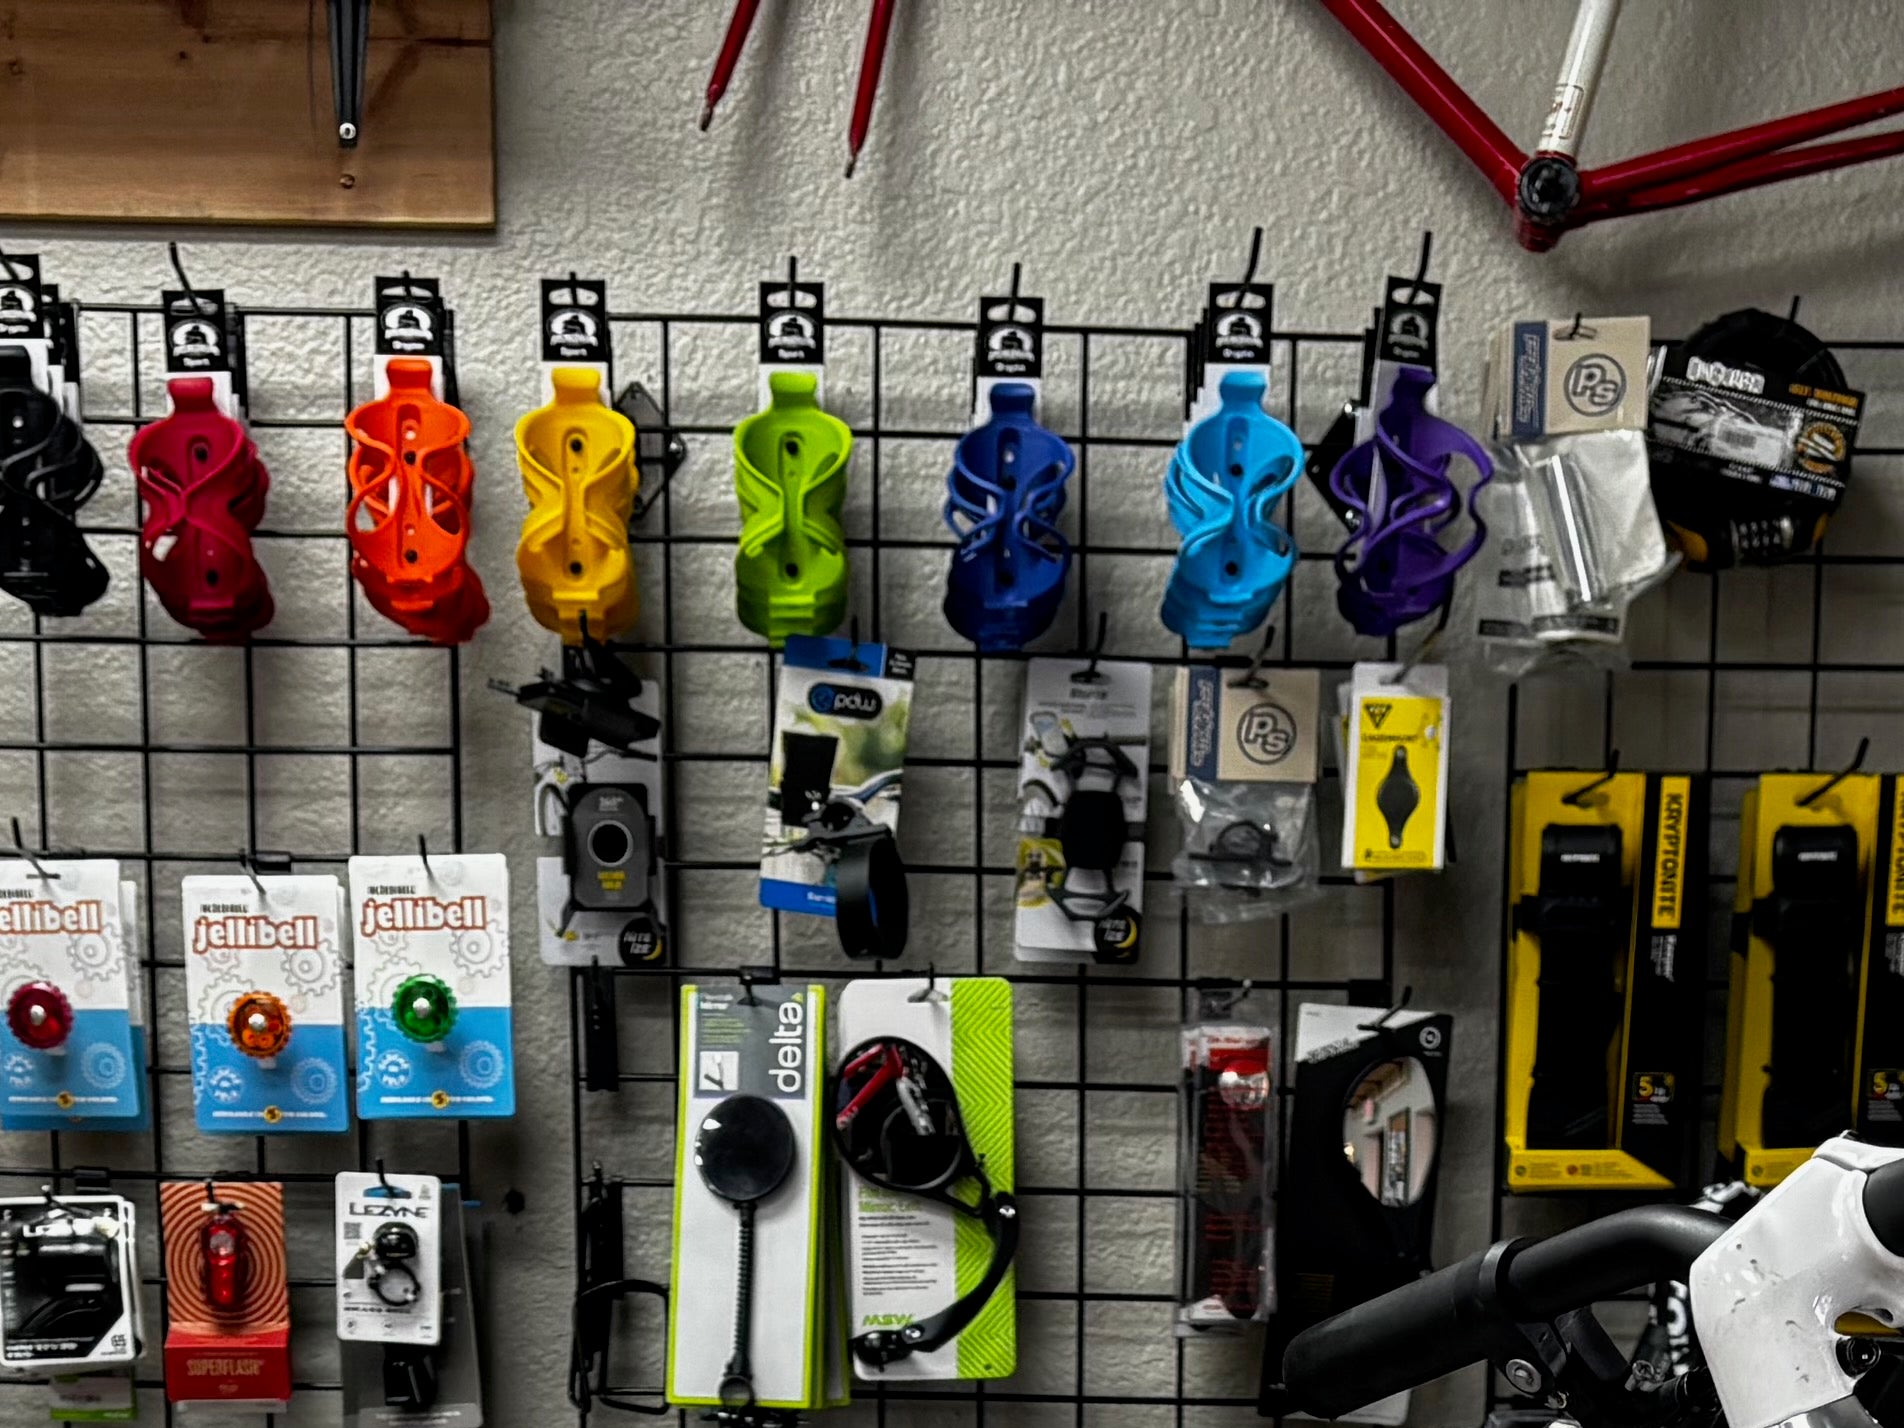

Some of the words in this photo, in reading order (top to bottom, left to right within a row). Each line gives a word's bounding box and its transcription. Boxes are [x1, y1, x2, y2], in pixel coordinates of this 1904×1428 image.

[1657, 791, 1684, 918] KRYPTONITE
[192, 916, 319, 955] jellibell
[360, 896, 486, 937] jellibell
[768, 1000, 803, 1093] delta
